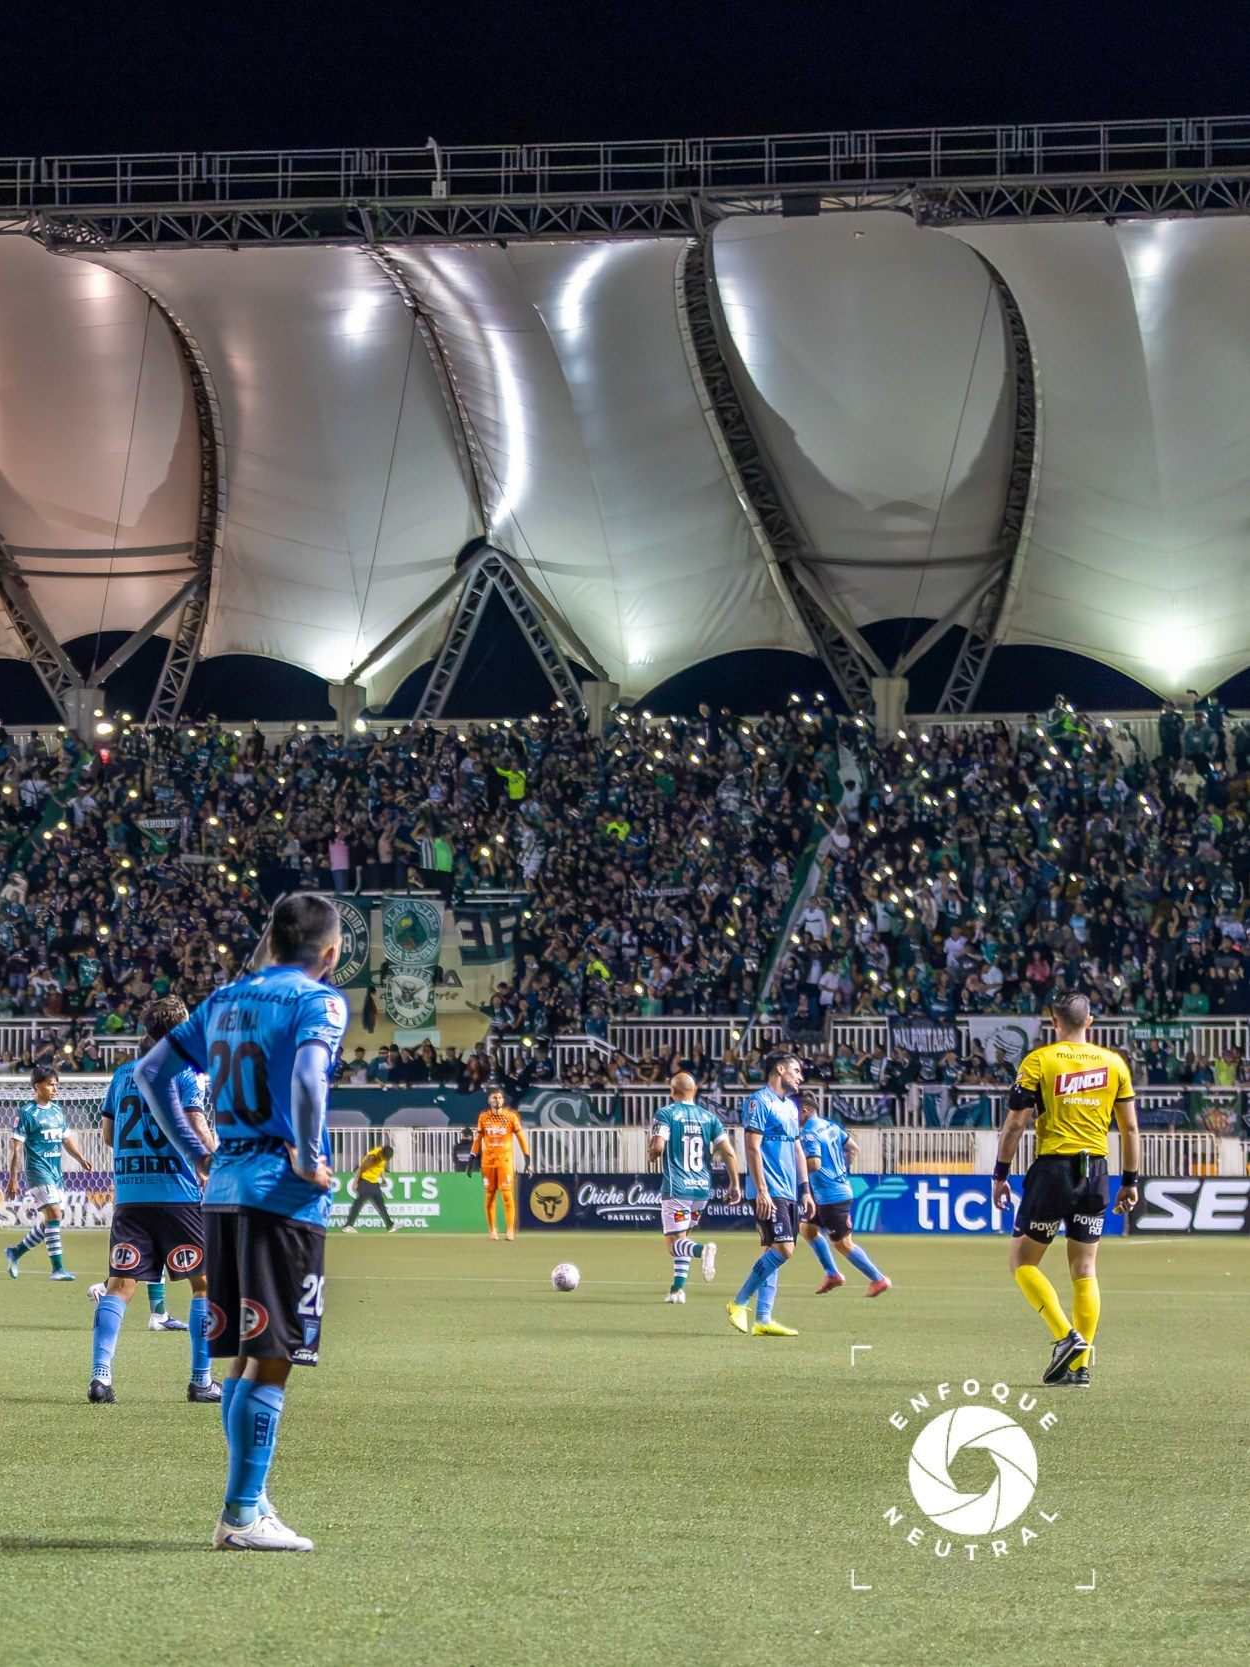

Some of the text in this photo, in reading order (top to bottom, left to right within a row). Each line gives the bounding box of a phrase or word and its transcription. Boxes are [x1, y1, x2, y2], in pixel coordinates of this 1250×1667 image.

[1057, 1052, 1102, 1060] marathon
[210, 1040, 272, 1125] 20
[1060, 1072, 1106, 1095] LANCO
[681, 1135, 704, 1172] 18
[578, 1184, 625, 1206] Chiche
[115, 1249, 132, 1264] PF
[175, 1251, 195, 1266] PF
